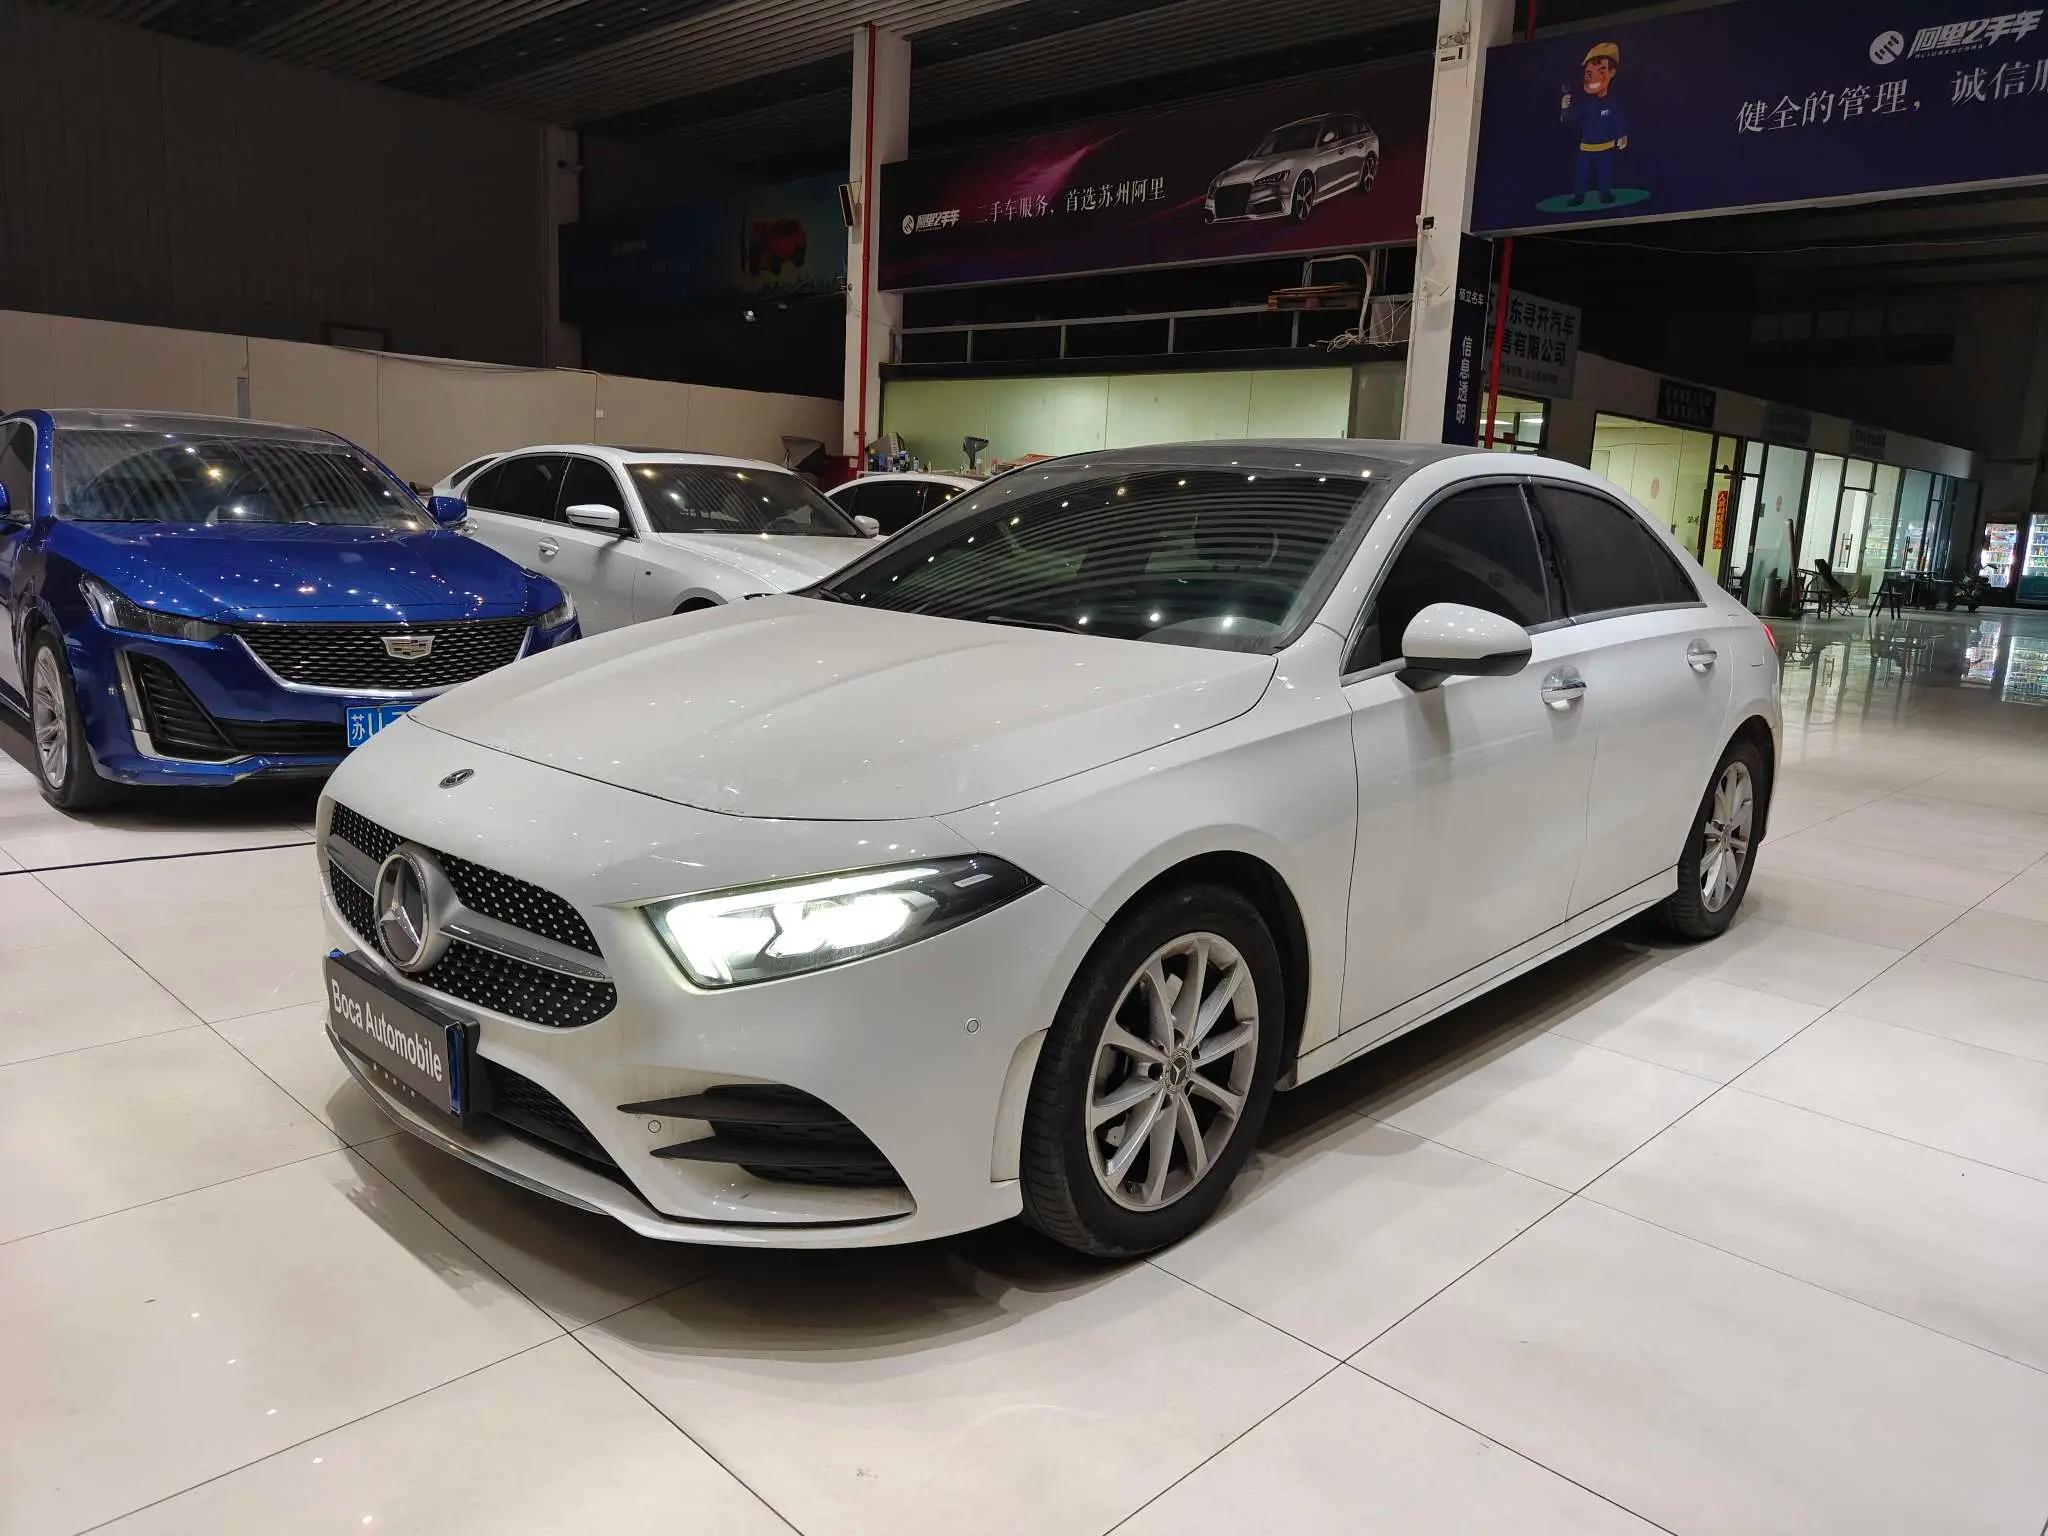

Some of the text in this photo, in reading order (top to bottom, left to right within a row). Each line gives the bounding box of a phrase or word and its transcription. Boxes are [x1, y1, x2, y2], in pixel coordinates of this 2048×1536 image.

[1066, 177, 1165, 214] 首选苏州阿里
[351, 712, 406, 740] 苏U
[331, 978, 443, 1083] Boca Automobile
